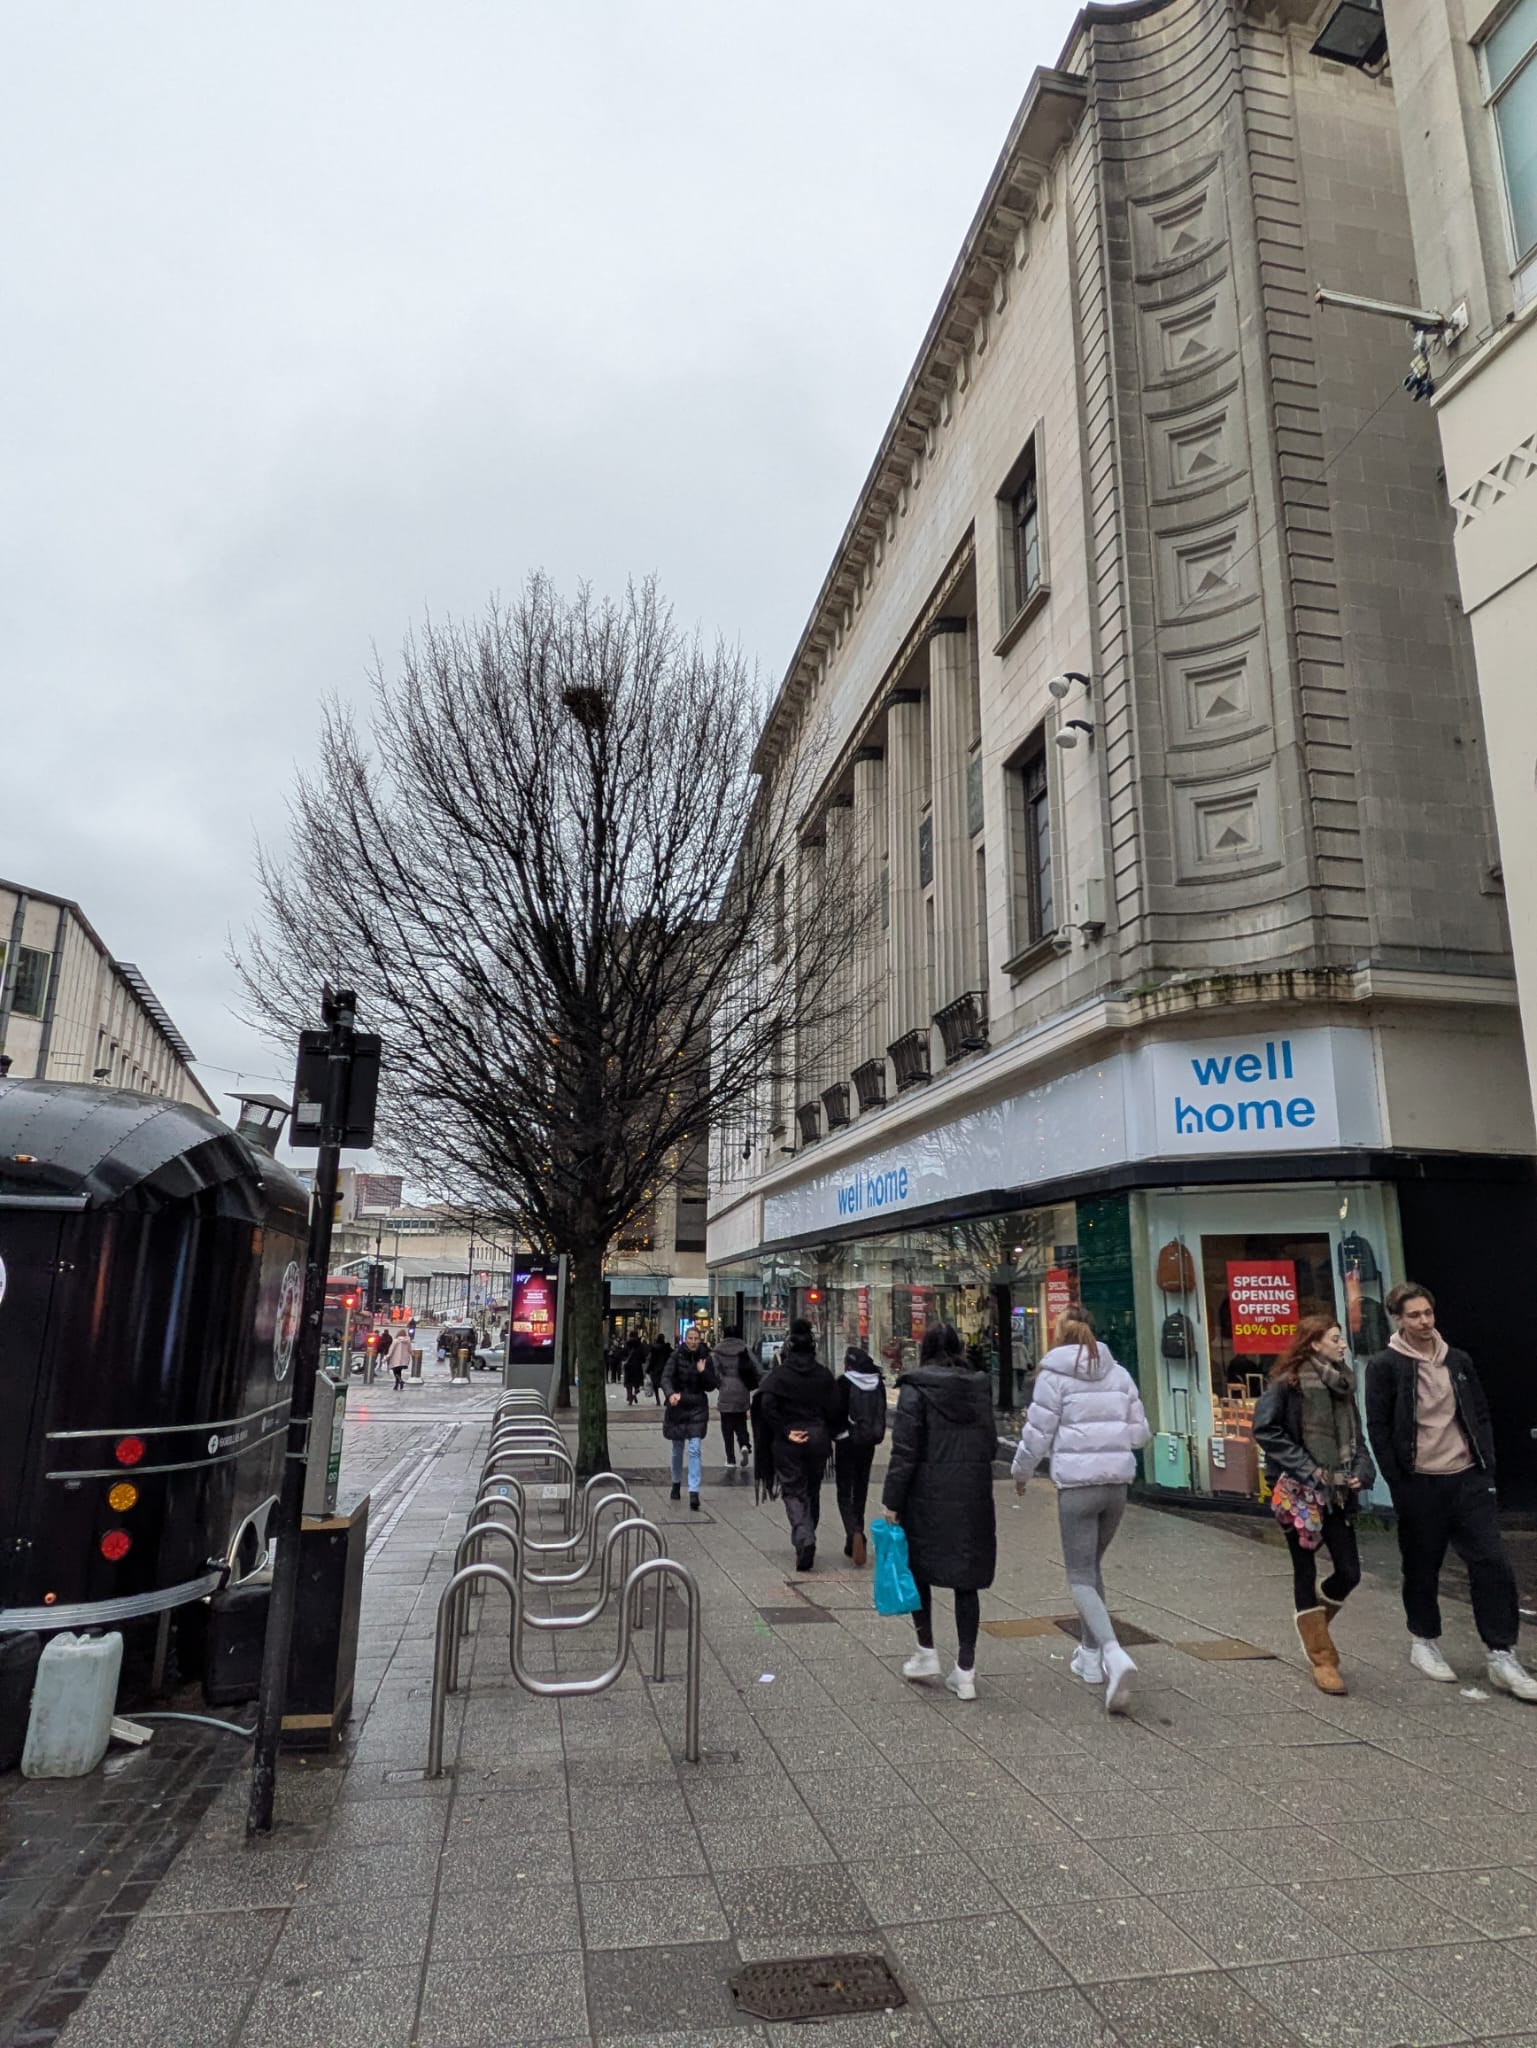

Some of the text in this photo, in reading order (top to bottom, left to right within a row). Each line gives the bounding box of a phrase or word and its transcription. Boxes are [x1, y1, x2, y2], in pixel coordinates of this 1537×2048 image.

[1191, 1040, 1293, 1086] well
[1175, 1096, 1316, 1134] home
[838, 1166, 908, 1216] well home
[1233, 1275, 1291, 1288] SPECIAL
[1232, 1289, 1295, 1301] OPENING
[1238, 1303, 1291, 1315] OFFERS
[1234, 1324, 1297, 1336] 50% OFF
